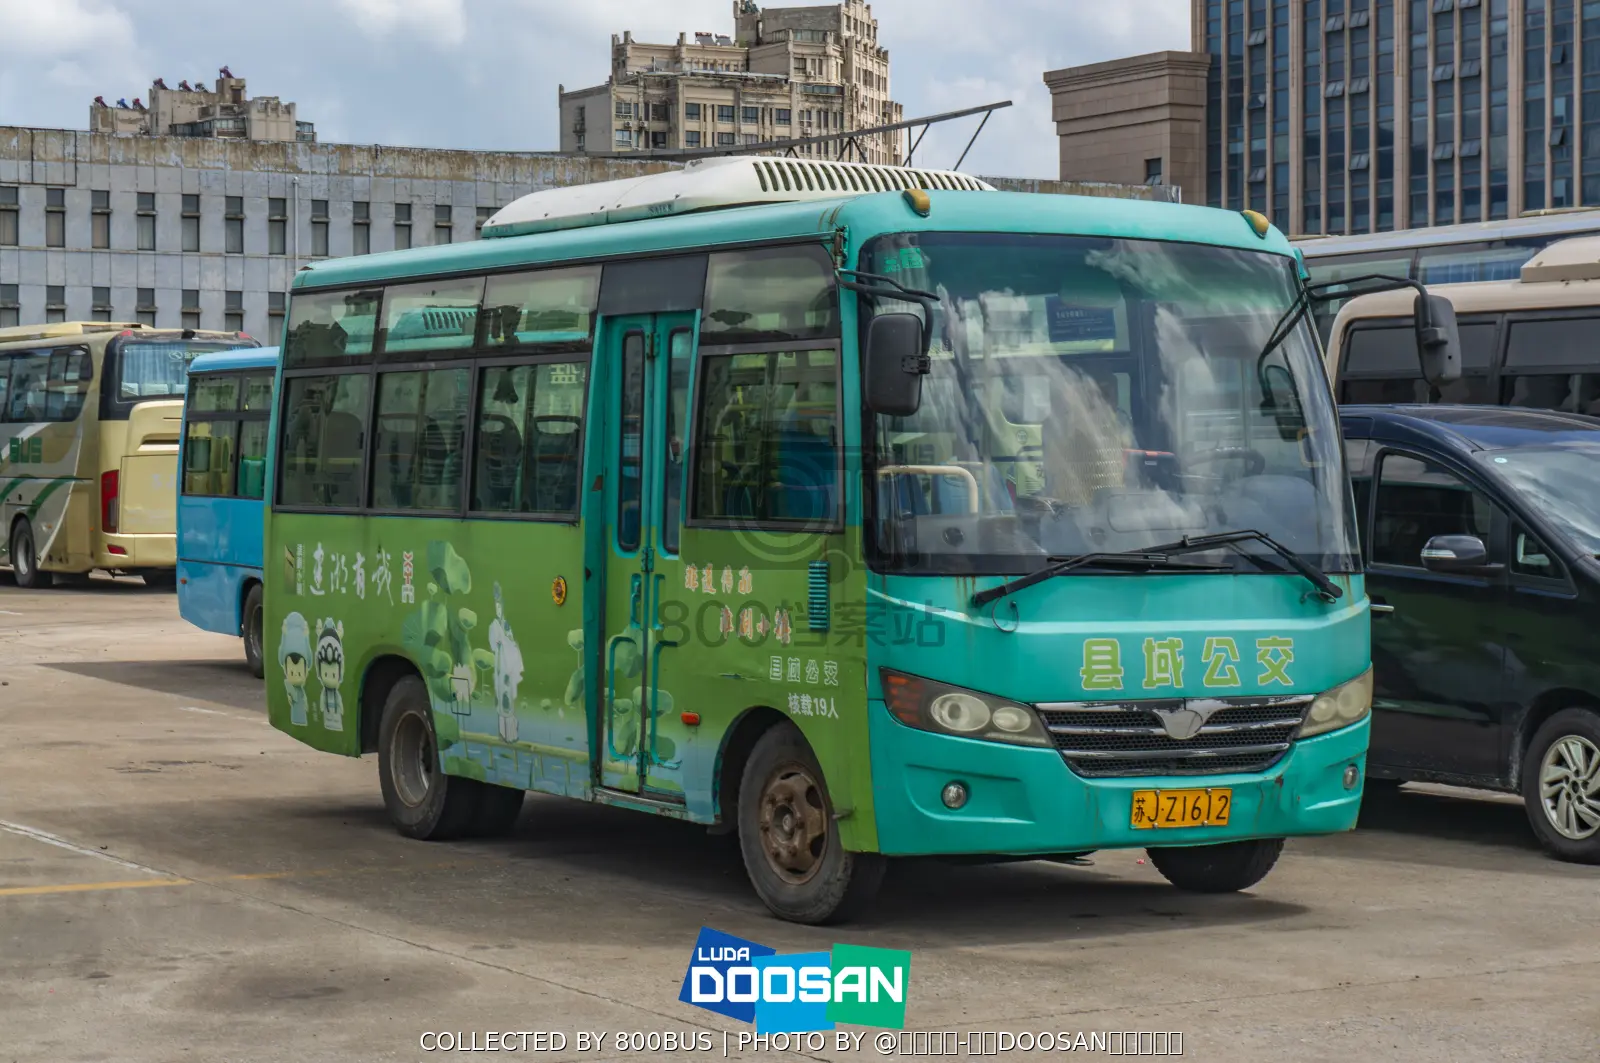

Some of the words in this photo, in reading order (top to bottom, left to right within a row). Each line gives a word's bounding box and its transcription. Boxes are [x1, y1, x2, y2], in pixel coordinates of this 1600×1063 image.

[1079, 634, 1295, 691] 县域公交
[787, 692, 839, 719] 核载19人
